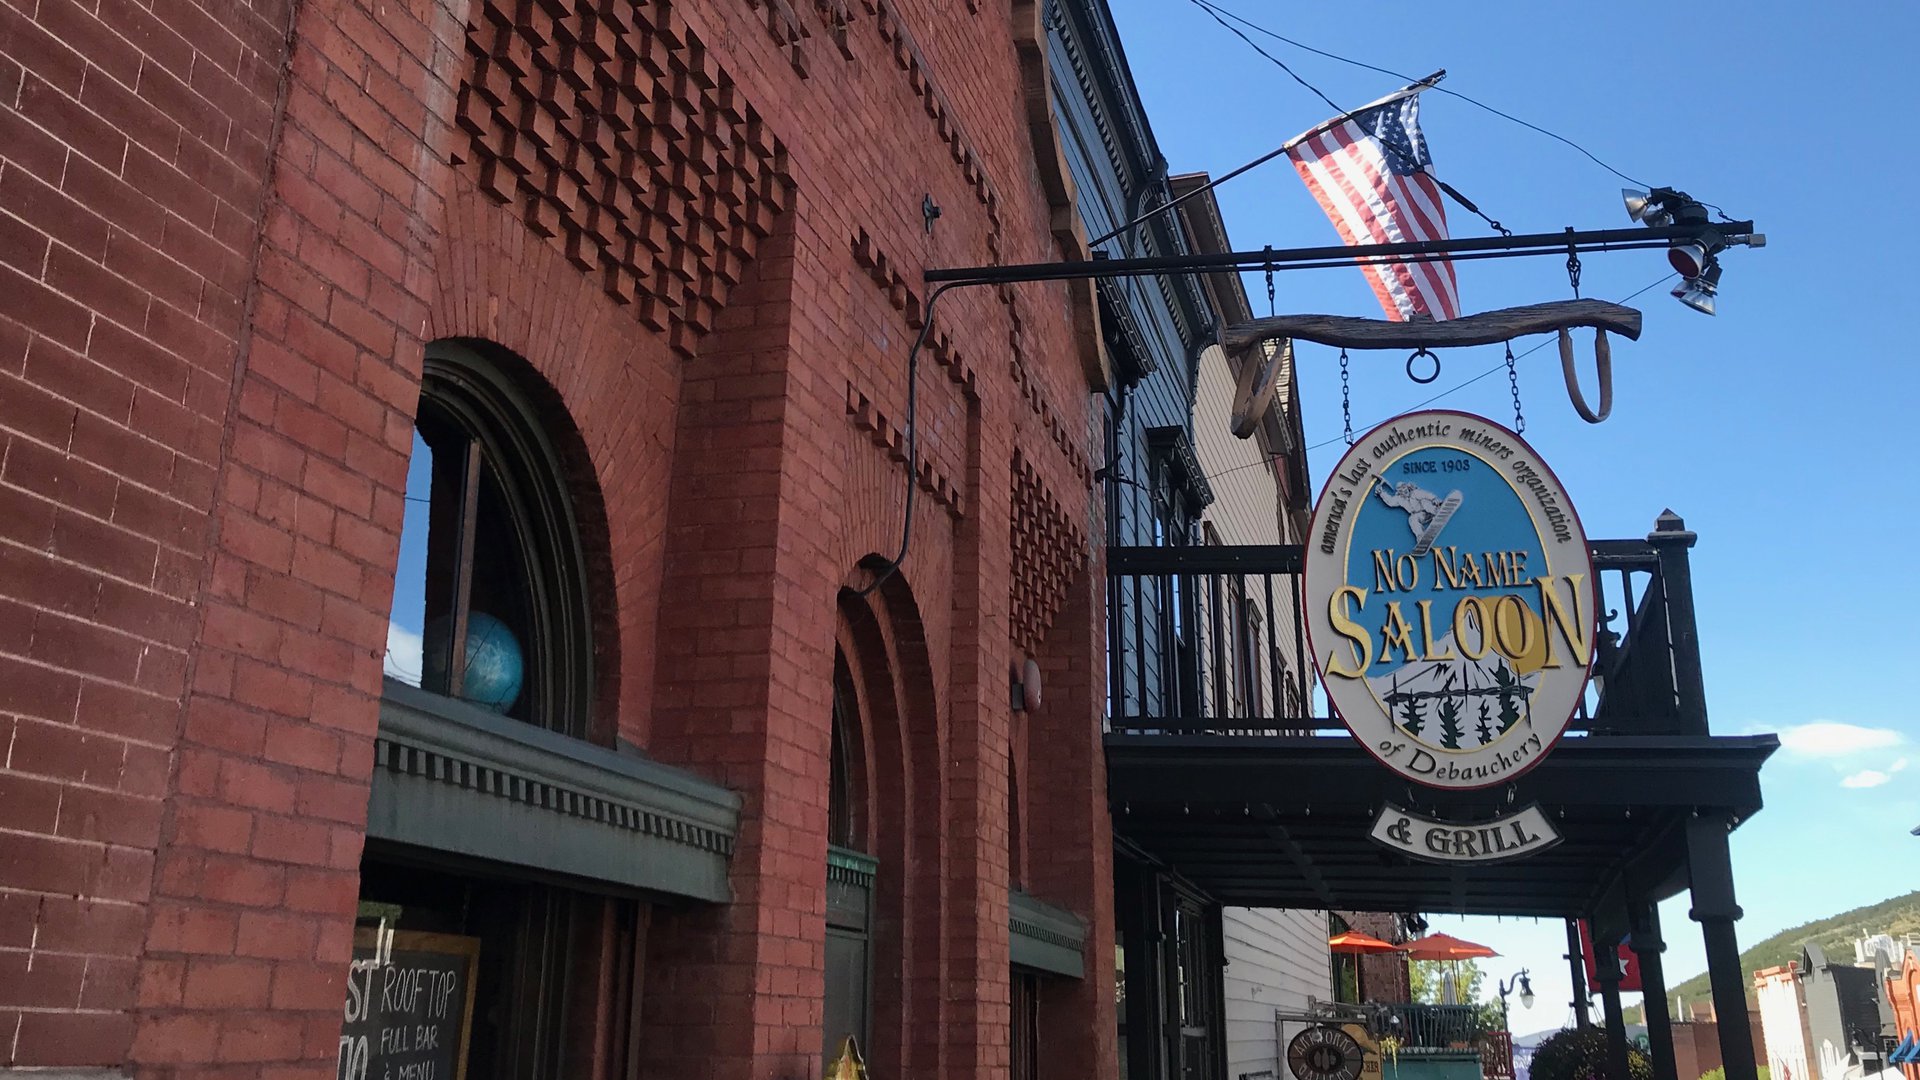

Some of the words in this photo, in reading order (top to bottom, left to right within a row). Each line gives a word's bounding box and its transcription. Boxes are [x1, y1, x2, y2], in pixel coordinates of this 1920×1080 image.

[1320, 490, 1353, 555] america's
[1338, 457, 1372, 487] last
[1372, 420, 1451, 459] authentic
[1459, 427, 1514, 460] miners
[1512, 460, 1572, 544] organization
[1402, 460, 1438, 474] SINCE
[1372, 548, 1420, 593] NO
[1432, 546, 1533, 590] NAME
[1324, 574, 1590, 678] SALOON
[1379, 741, 1406, 758] of
[1404, 733, 1542, 781] Debauchery
[1387, 817, 1413, 845] &
[1425, 820, 1541, 857] GRILL
[344, 958, 378, 1023] ST
[381, 966, 456, 1019] ROOFTOP
[380, 1025, 409, 1055] FULL
[415, 1024, 439, 1050] BAR
[398, 1060, 435, 1080] MENU
